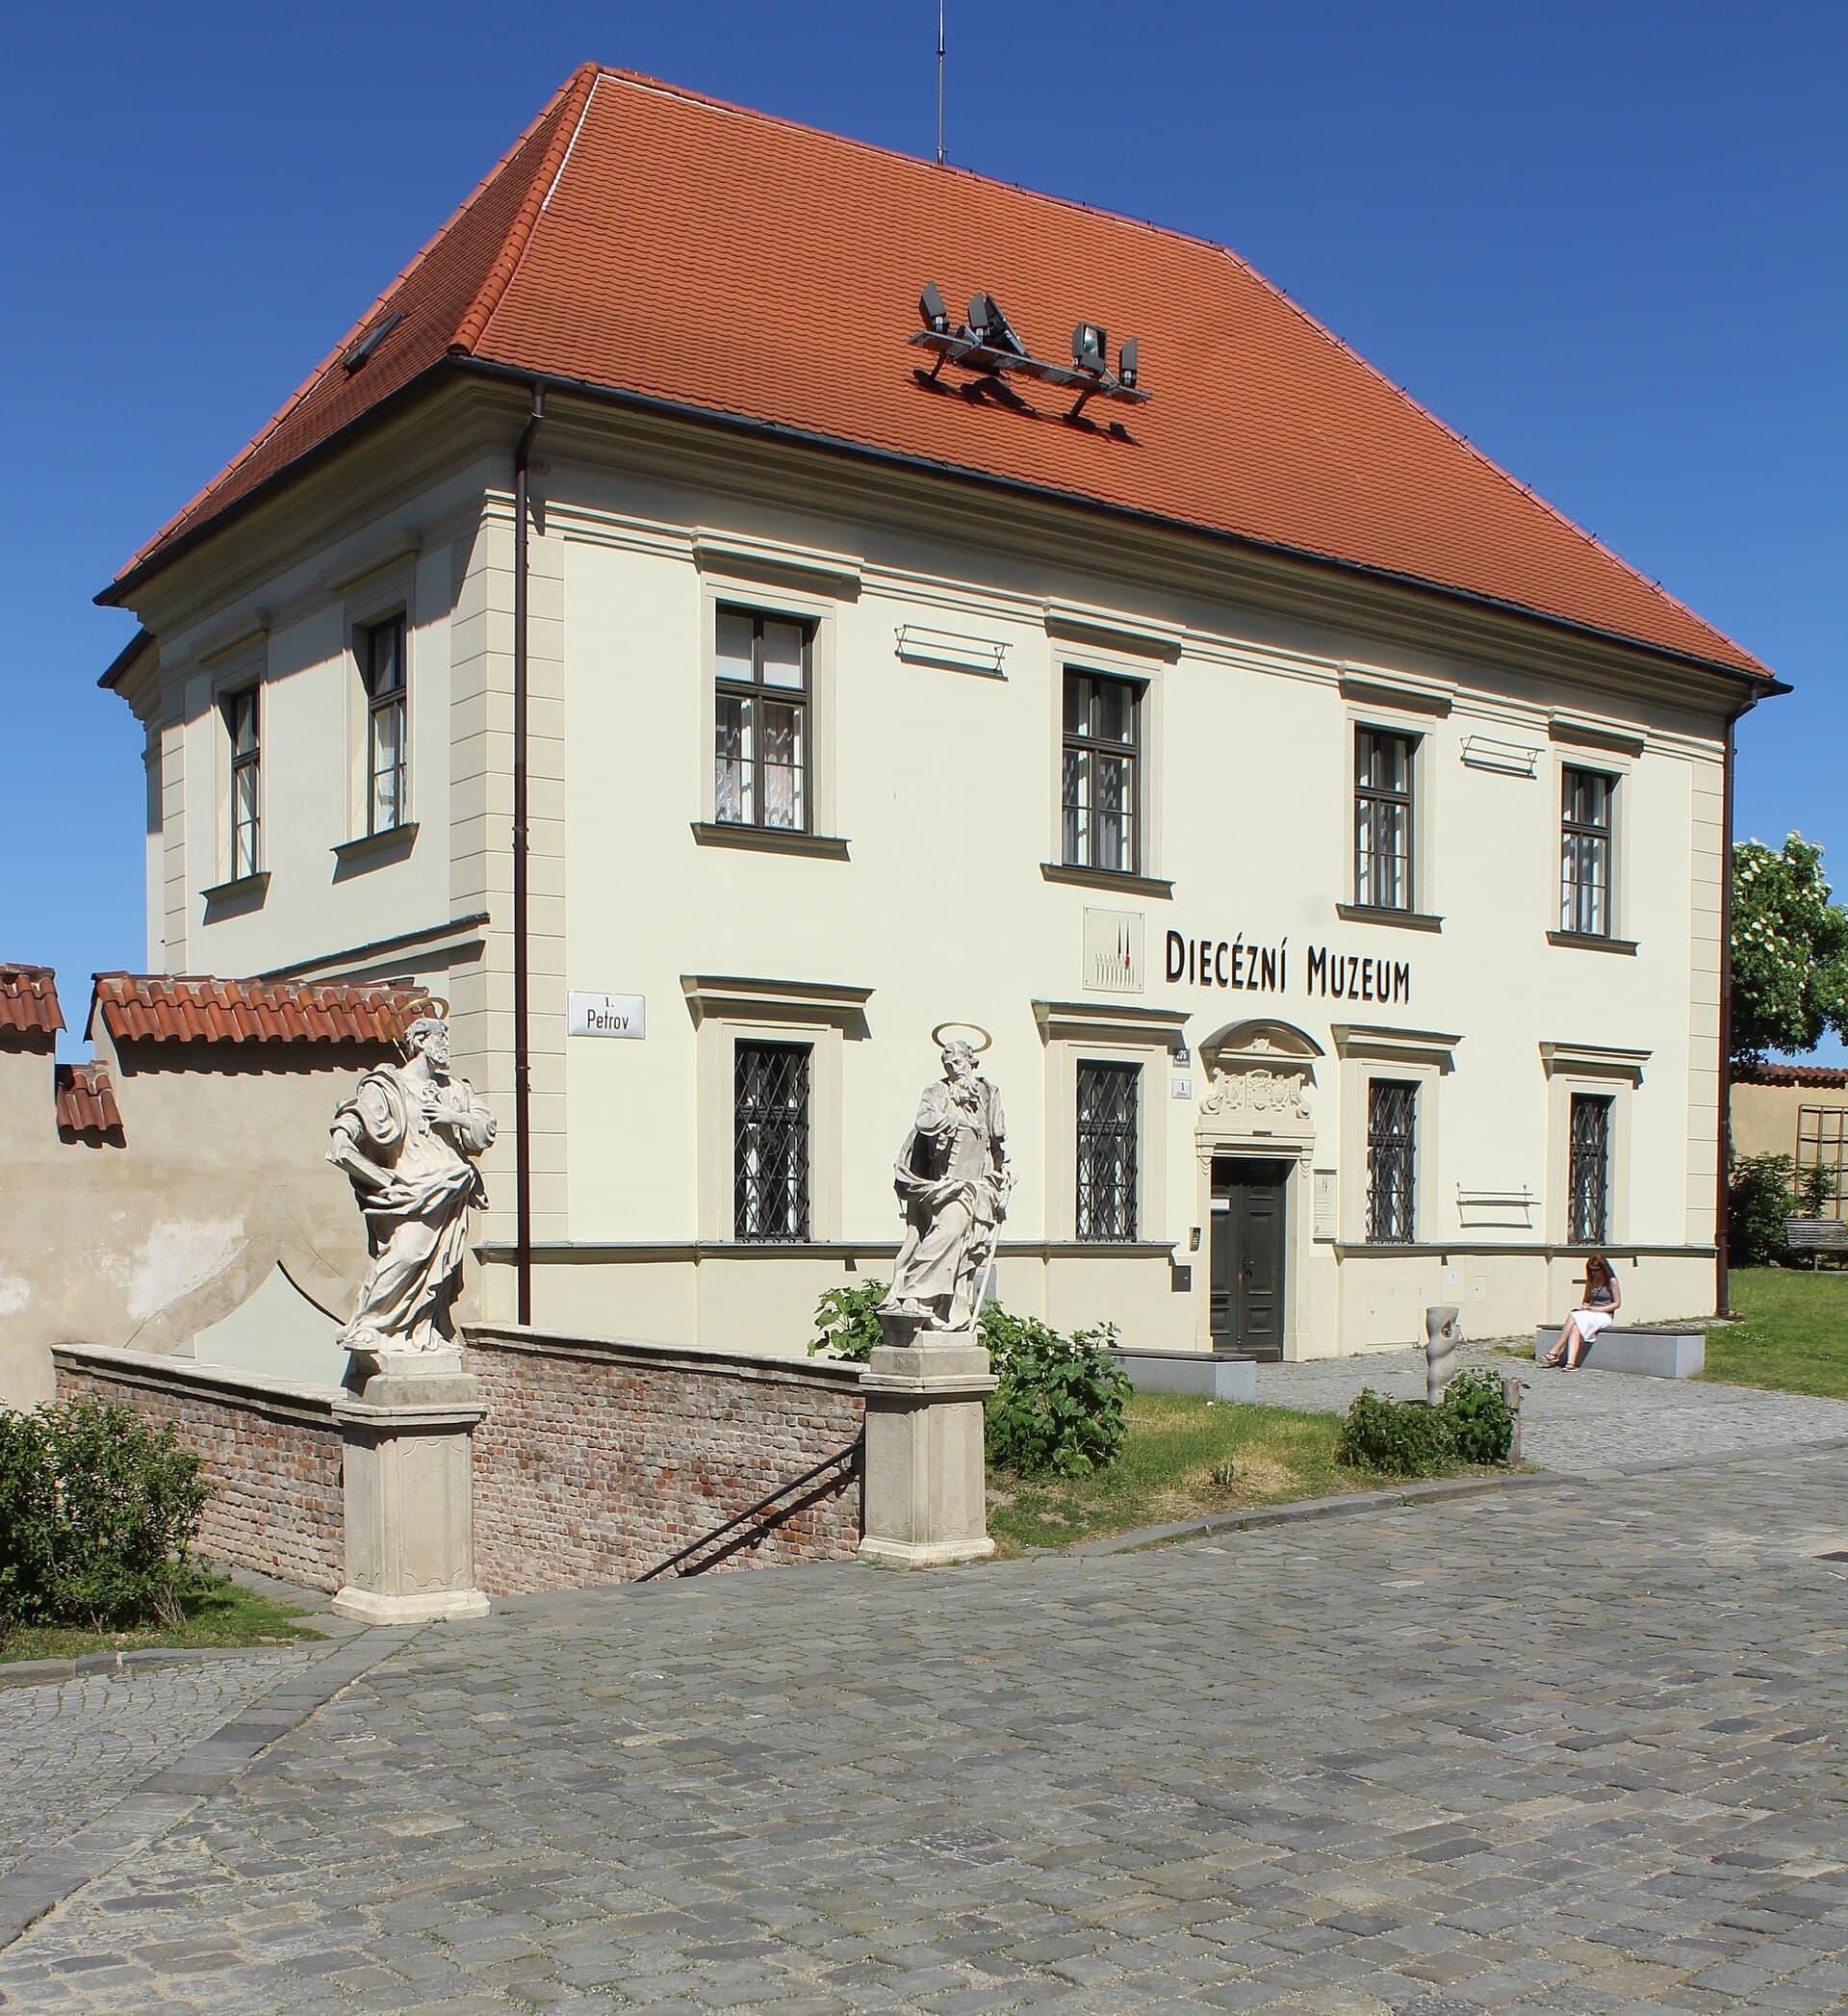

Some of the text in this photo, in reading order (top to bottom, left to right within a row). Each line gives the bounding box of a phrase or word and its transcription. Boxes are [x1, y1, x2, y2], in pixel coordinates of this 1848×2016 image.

[1166, 929, 1409, 1004] DIECÉZNÍ MUZEUM
[587, 1009, 629, 1030] Petrov
